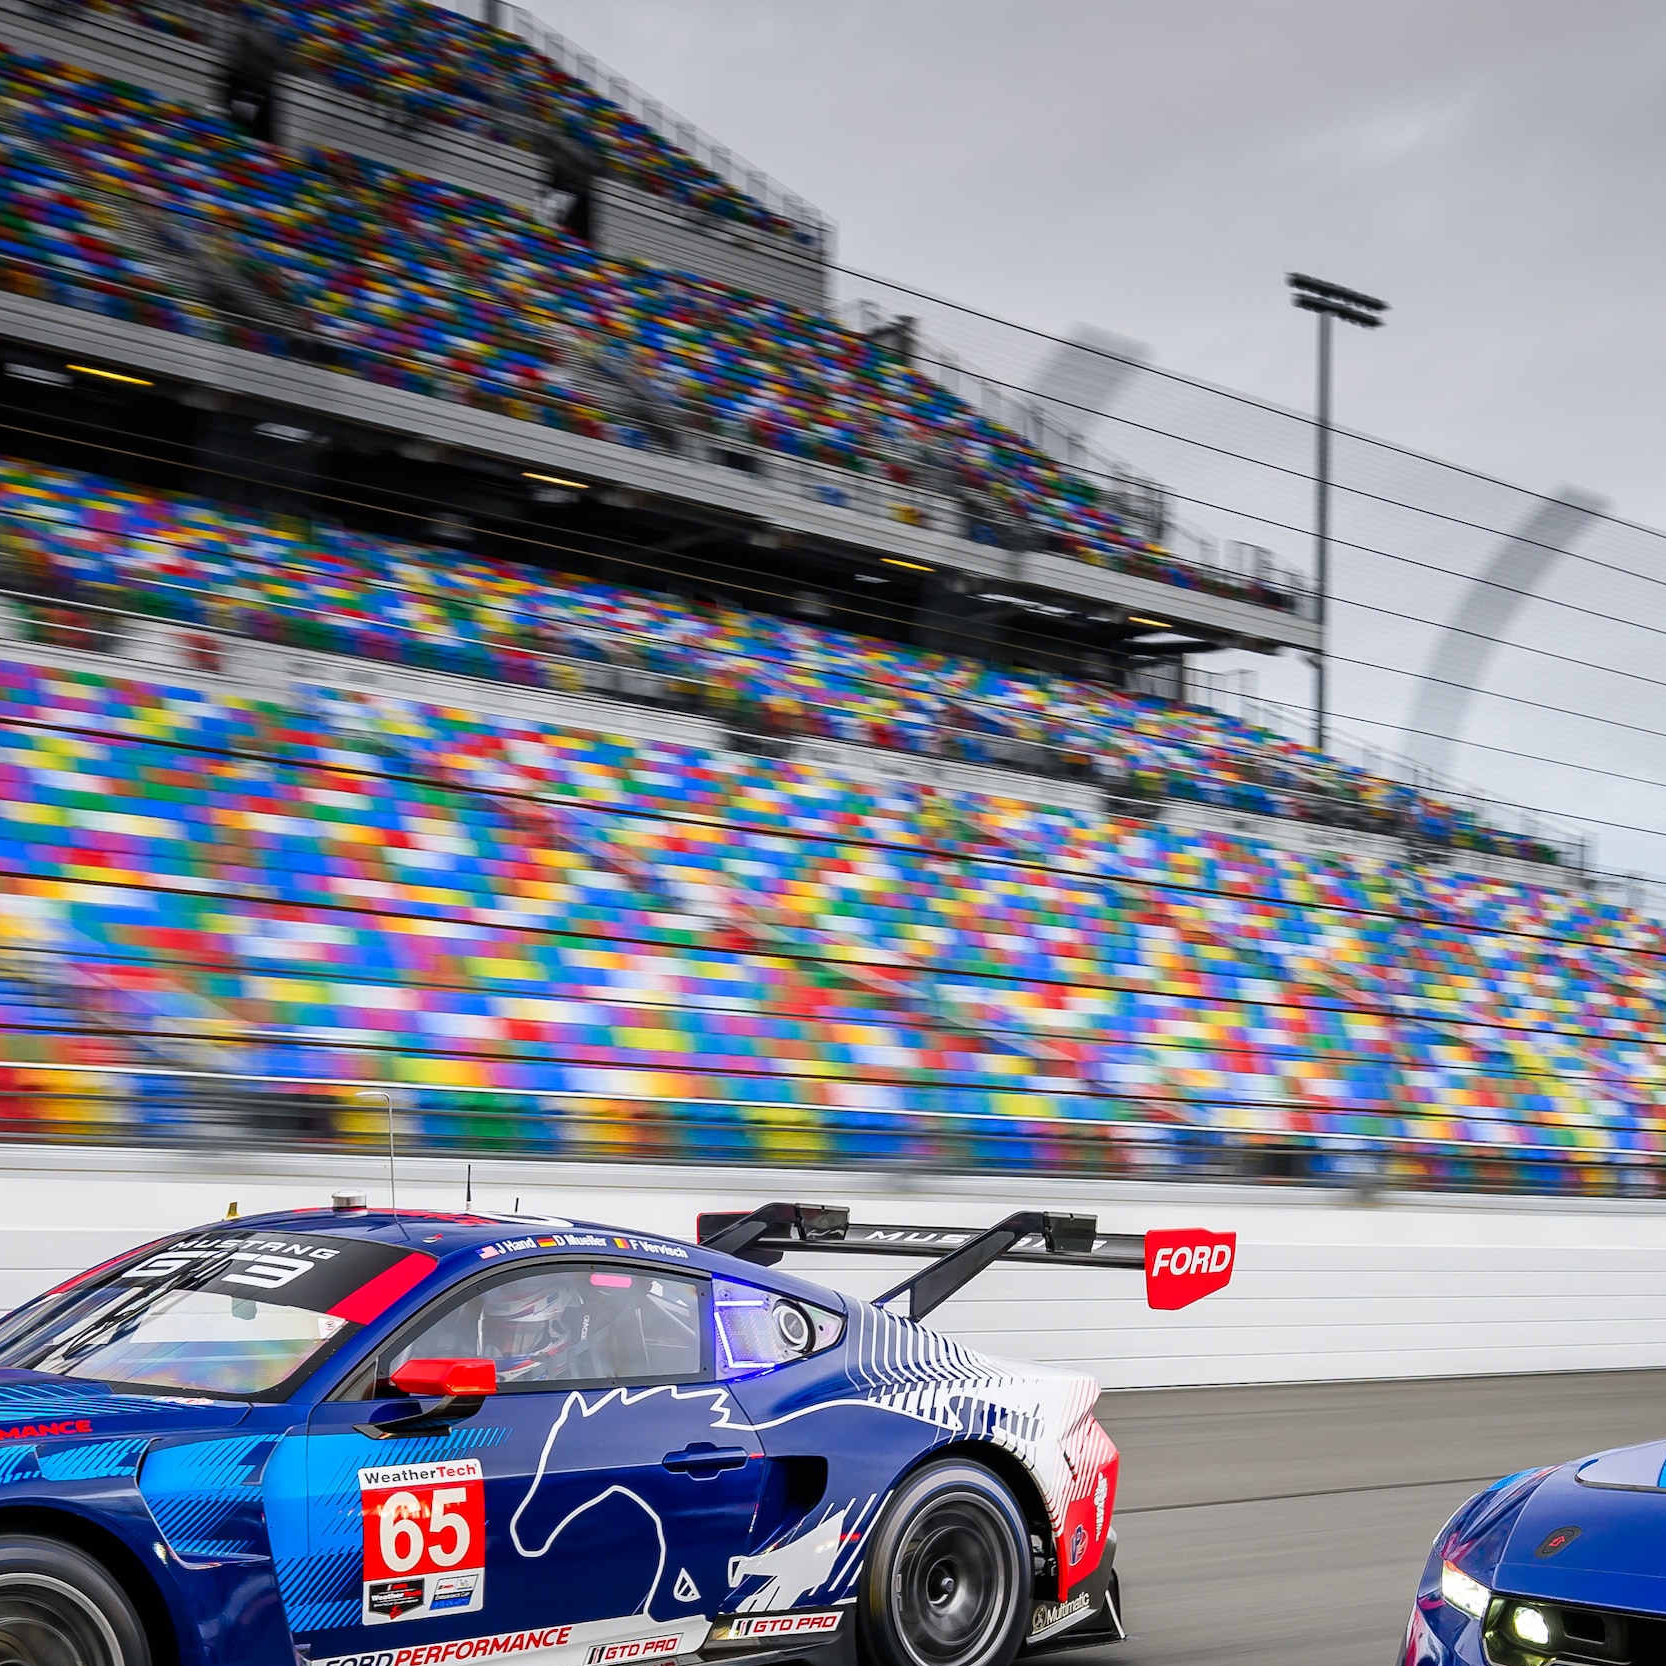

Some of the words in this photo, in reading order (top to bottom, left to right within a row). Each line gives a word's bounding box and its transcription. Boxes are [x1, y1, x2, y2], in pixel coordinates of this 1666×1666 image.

[168, 1239, 341, 1260] MUSTANG
[496, 1243, 507, 1255] J
[507, 1237, 537, 1252] Hand
[554, 1235, 565, 1247] D
[564, 1234, 608, 1247] Mueller
[630, 1239, 641, 1250] F
[639, 1240, 689, 1259] Vervisch
[121, 1250, 315, 1289] GT3
[1152, 1244, 1232, 1277] FORD
[364, 1464, 477, 1484] WeatherTech
[379, 1487, 471, 1572] 65
[1046, 1591, 1090, 1625] Multimatic
[753, 1619, 793, 1633] GTD
[795, 1616, 837, 1630] PRO
[604, 1643, 641, 1660] GTD
[642, 1637, 678, 1655] PRO
